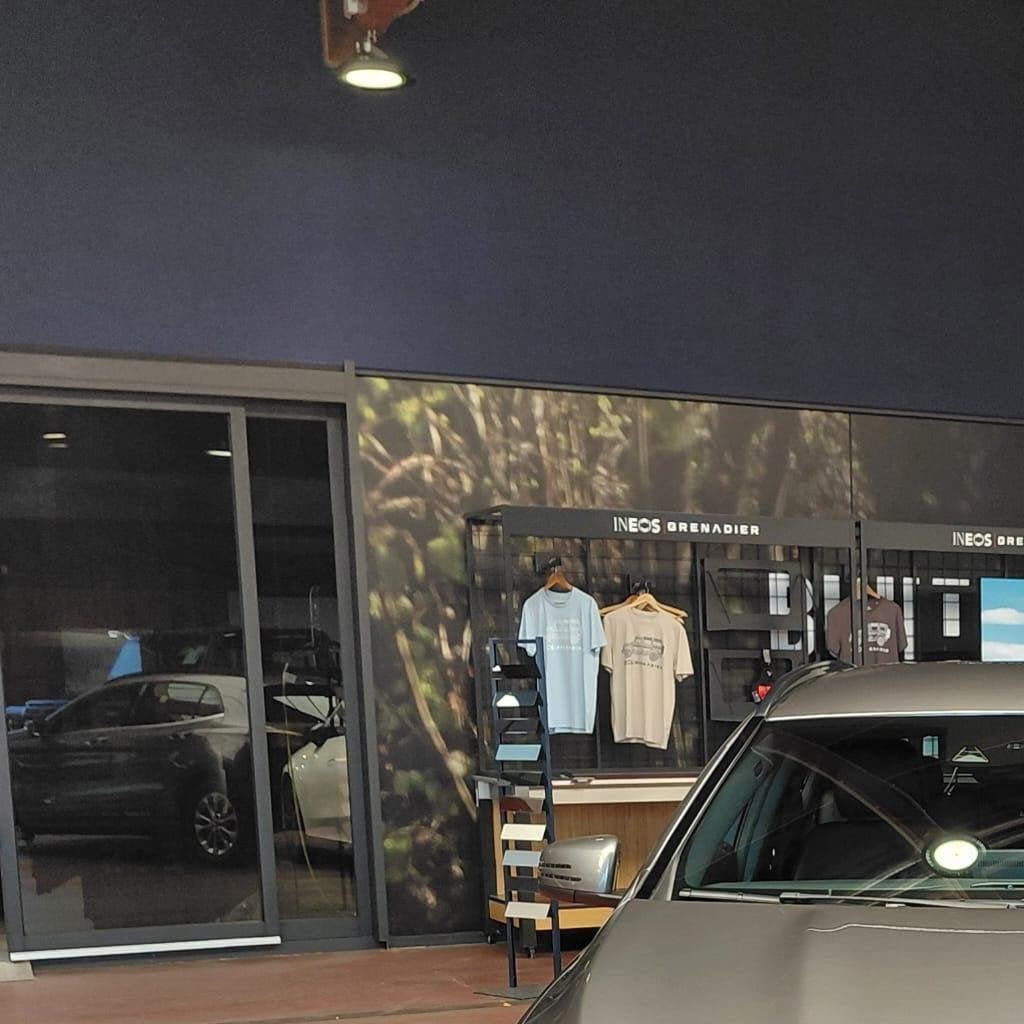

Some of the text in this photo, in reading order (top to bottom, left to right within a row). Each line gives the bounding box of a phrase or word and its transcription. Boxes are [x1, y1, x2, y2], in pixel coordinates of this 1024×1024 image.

[613, 516, 760, 535] INEOS GRENADIER
[952, 531, 992, 547] INEOS
